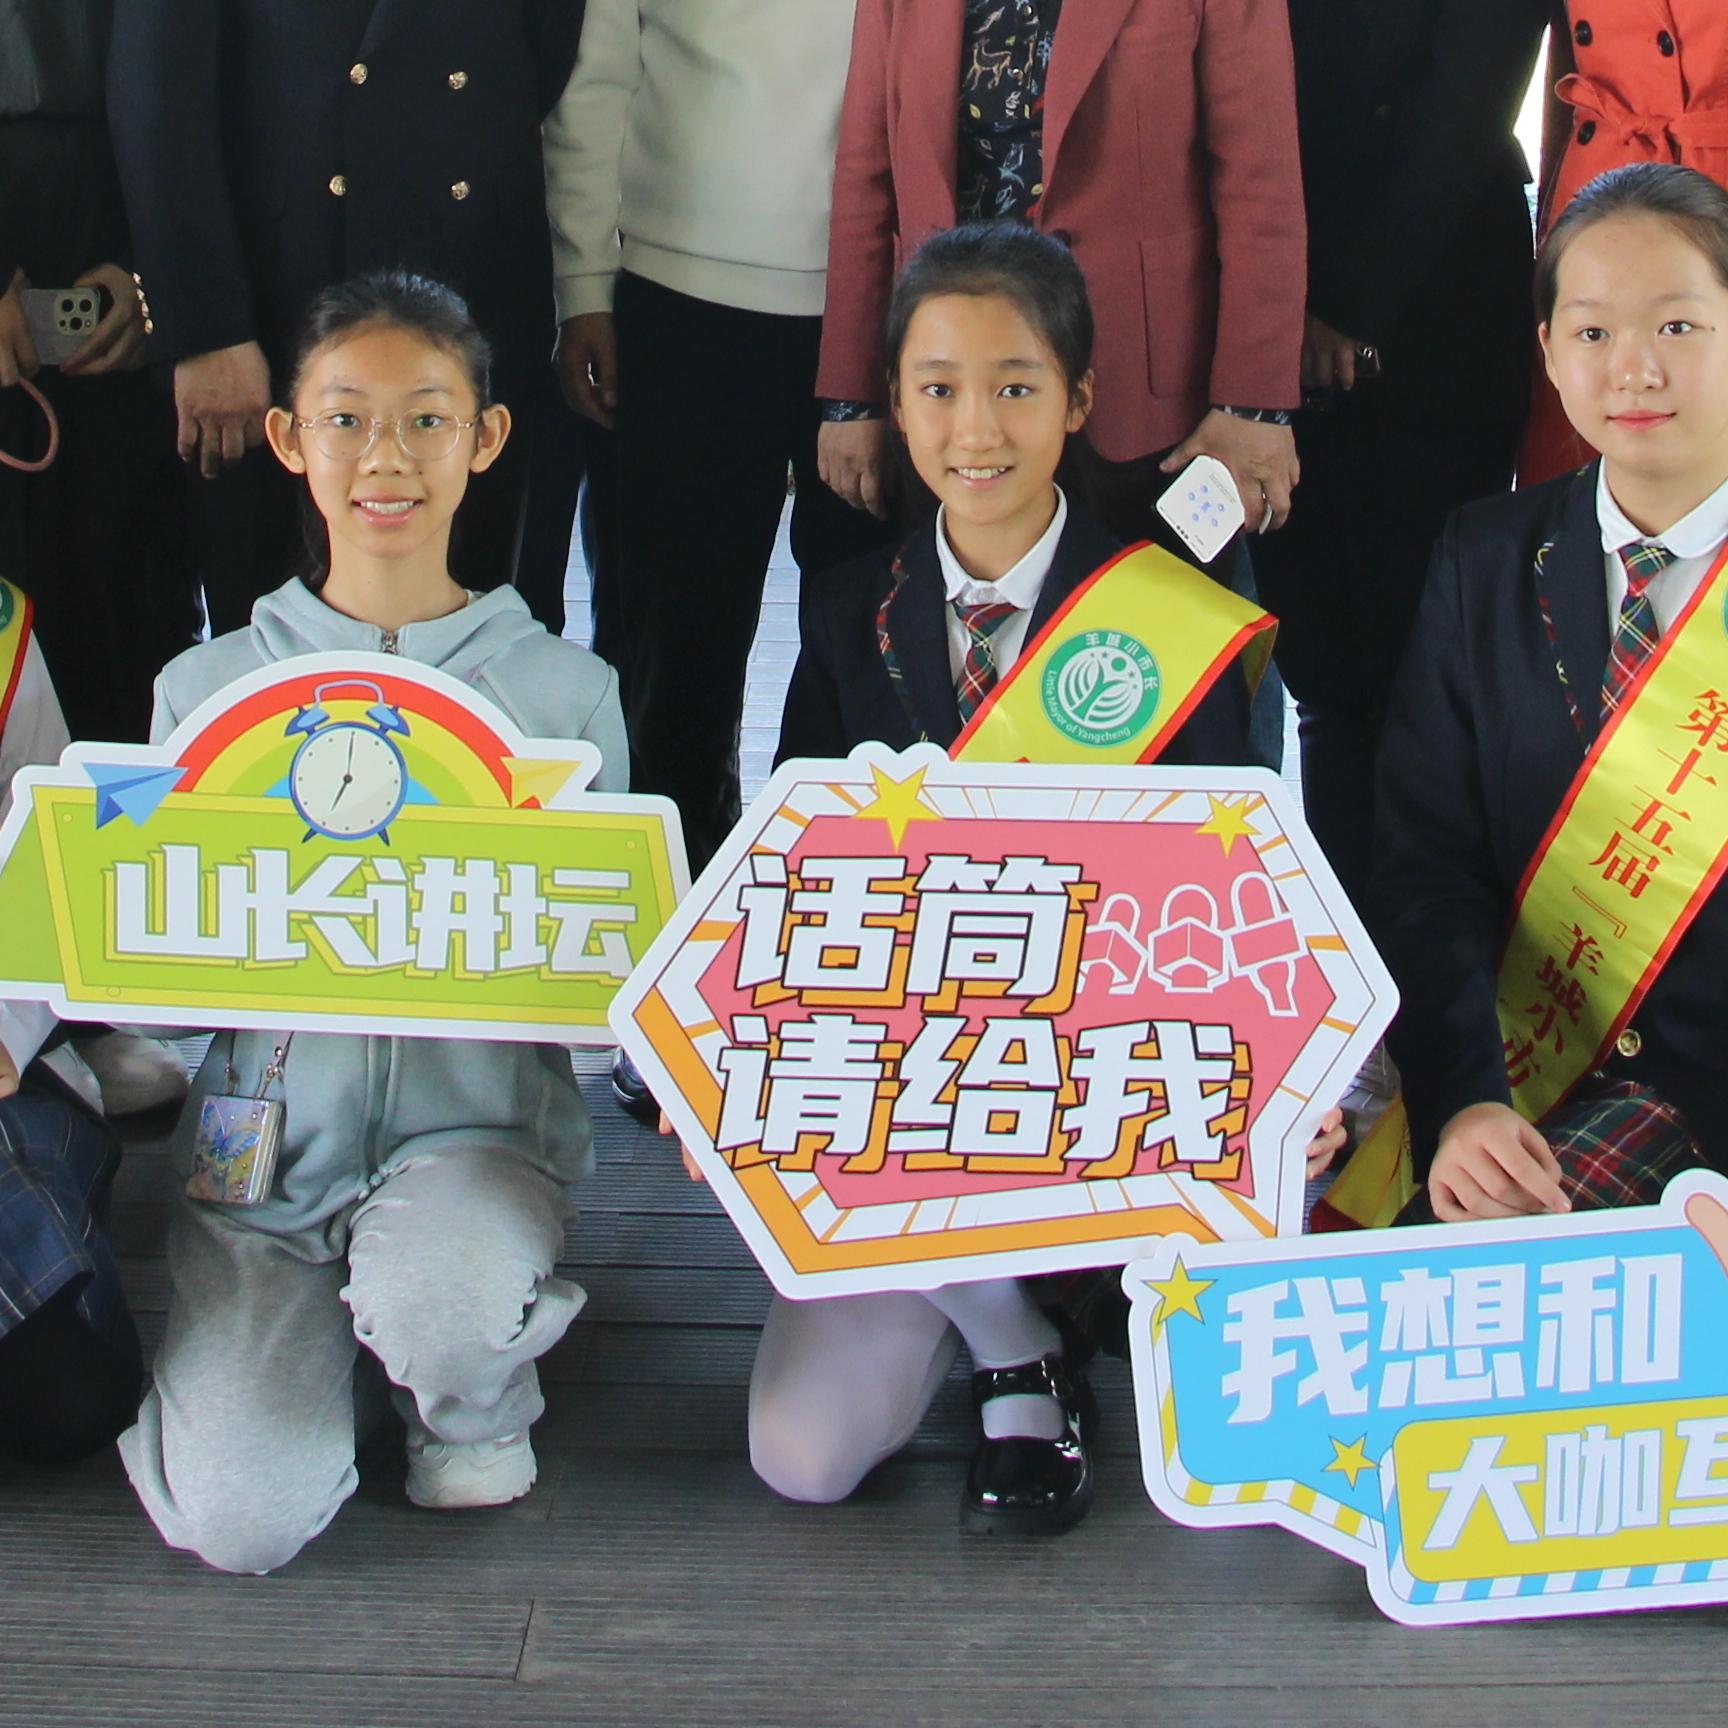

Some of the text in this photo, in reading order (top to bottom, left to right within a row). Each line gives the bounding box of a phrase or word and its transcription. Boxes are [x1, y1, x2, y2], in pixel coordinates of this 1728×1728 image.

[1077, 727, 1131, 743] Yangcheng
[105, 843, 638, 981] 山长讲坛
[734, 852, 1090, 1004] 话筒
[716, 1013, 1242, 1174] 请给我
[1220, 1252, 1684, 1424] 我想和
